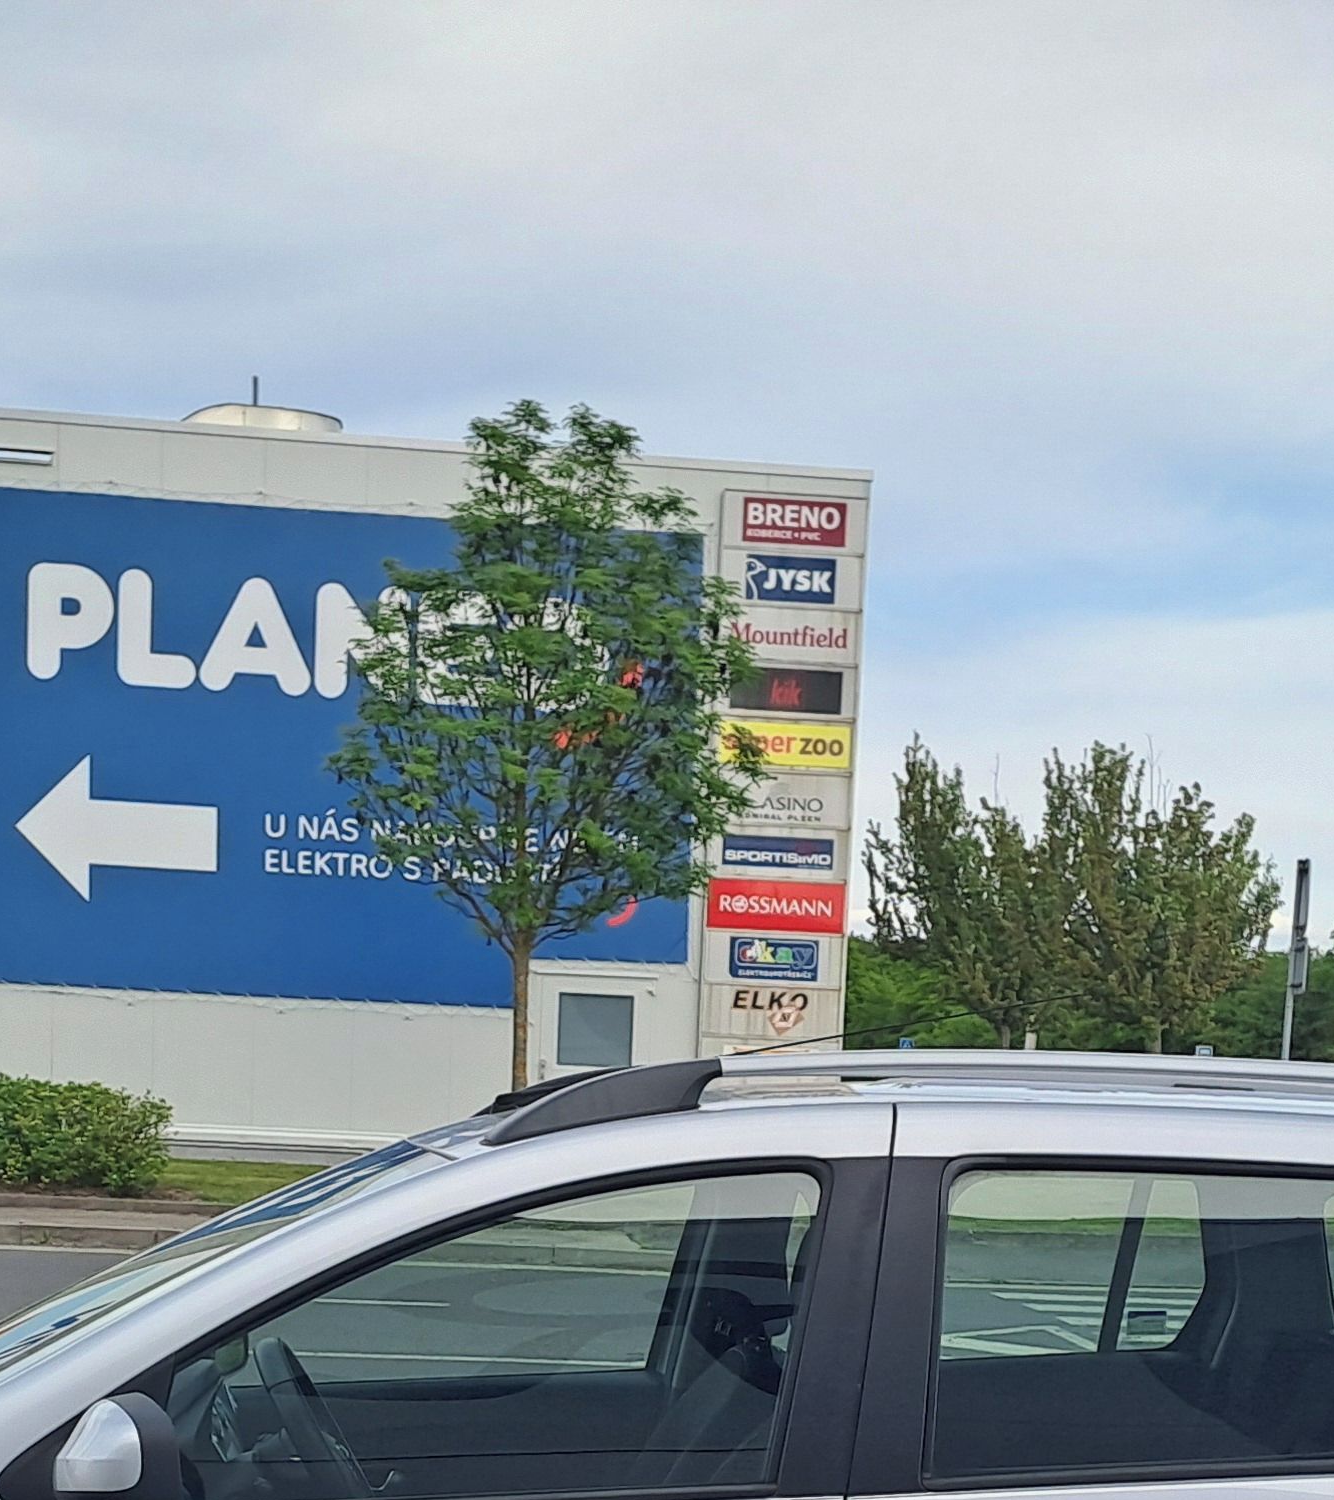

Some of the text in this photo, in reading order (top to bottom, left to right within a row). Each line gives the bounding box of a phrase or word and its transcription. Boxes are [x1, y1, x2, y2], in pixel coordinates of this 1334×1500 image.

[747, 502, 841, 530] BRENO
[763, 567, 832, 593] JYSK
[731, 622, 848, 649] Mountfield
[747, 796, 823, 812] ASINO
[265, 813, 286, 839] U
[298, 808, 360, 842] NÁS
[264, 848, 393, 880] ELEKTRO
[403, 856, 422, 881] S
[719, 894, 832, 917] ROSSMANN
[732, 990, 808, 1011] ELKO
